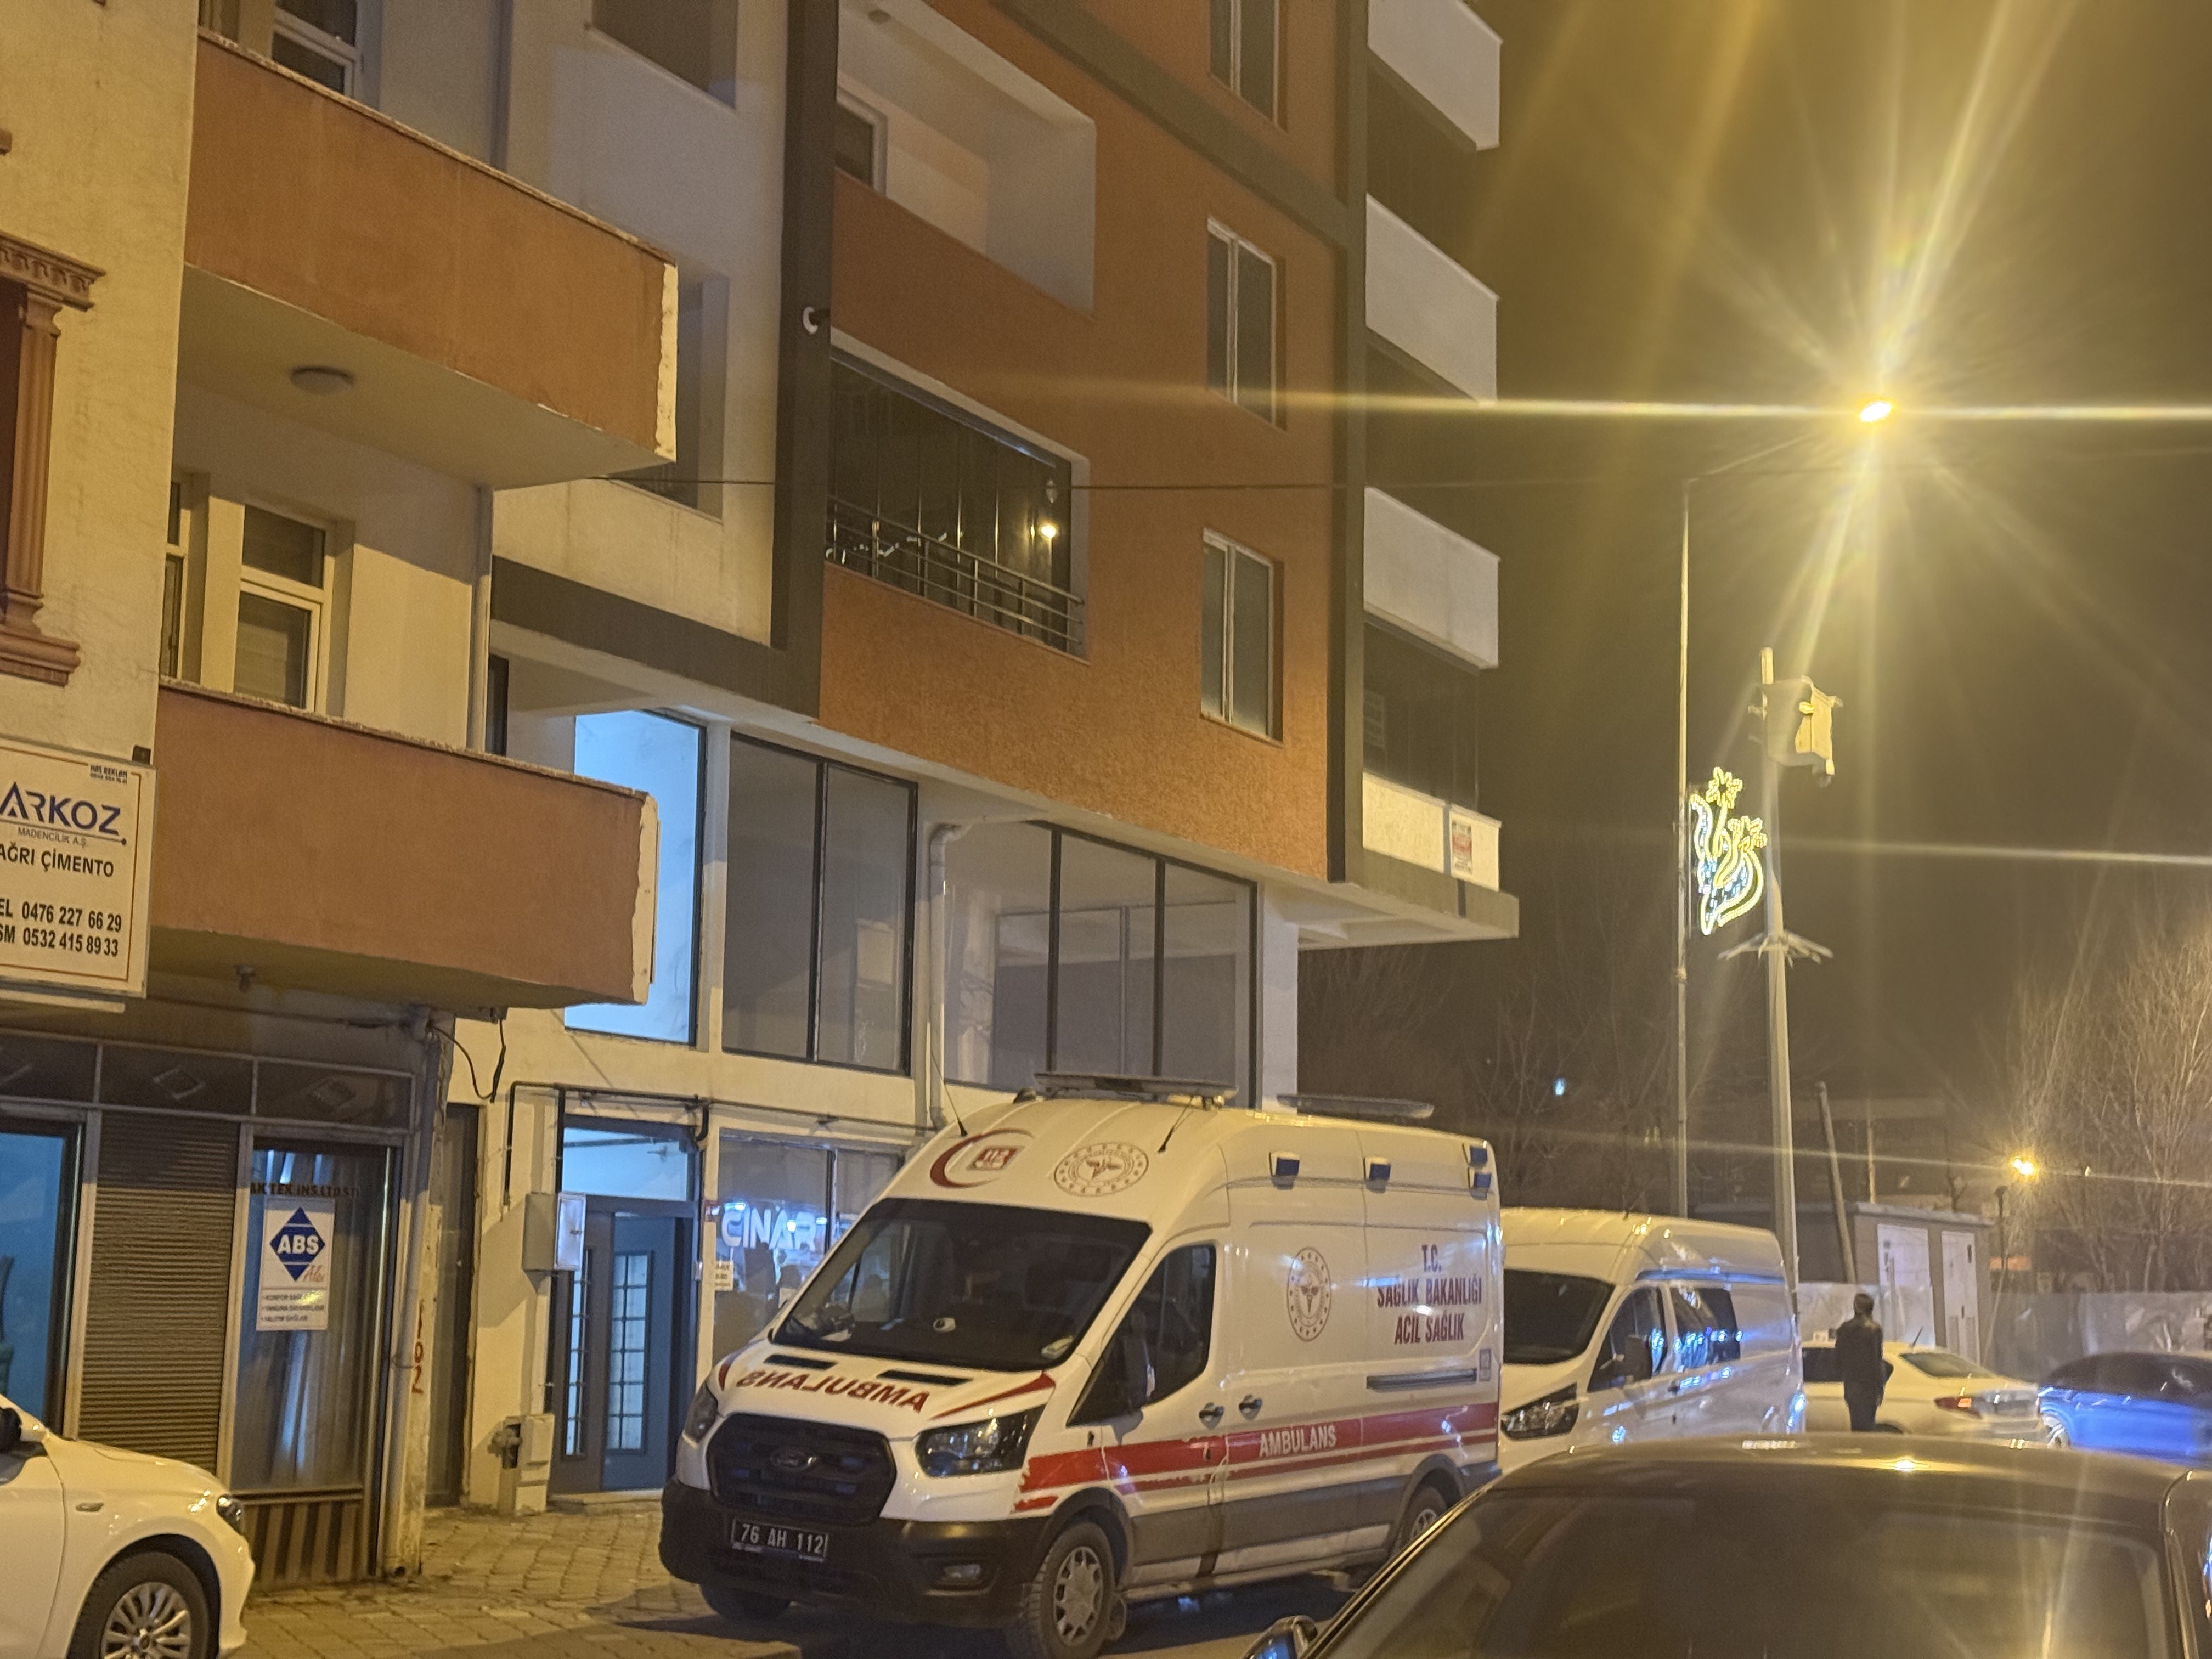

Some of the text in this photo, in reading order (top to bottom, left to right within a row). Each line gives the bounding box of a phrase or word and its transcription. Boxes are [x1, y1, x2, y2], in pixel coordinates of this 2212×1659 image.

[41, 848, 114, 878] ÇİMENTO
[22, 901, 54, 923] 0476
[59, 906, 83, 927] 227
[88, 910, 103, 929] 66
[106, 913, 122, 933] 29
[22, 927, 55, 949] 0532
[59, 932, 83, 952] 415
[276, 1234, 319, 1255] ABS
[1426, 1274, 1481, 1306] BAKANLIĞI
[1425, 1310, 1465, 1342] SAĞLIK
[1259, 1424, 1337, 1458] AMBULANS
[741, 1523, 823, 1554] 76 AH 112
